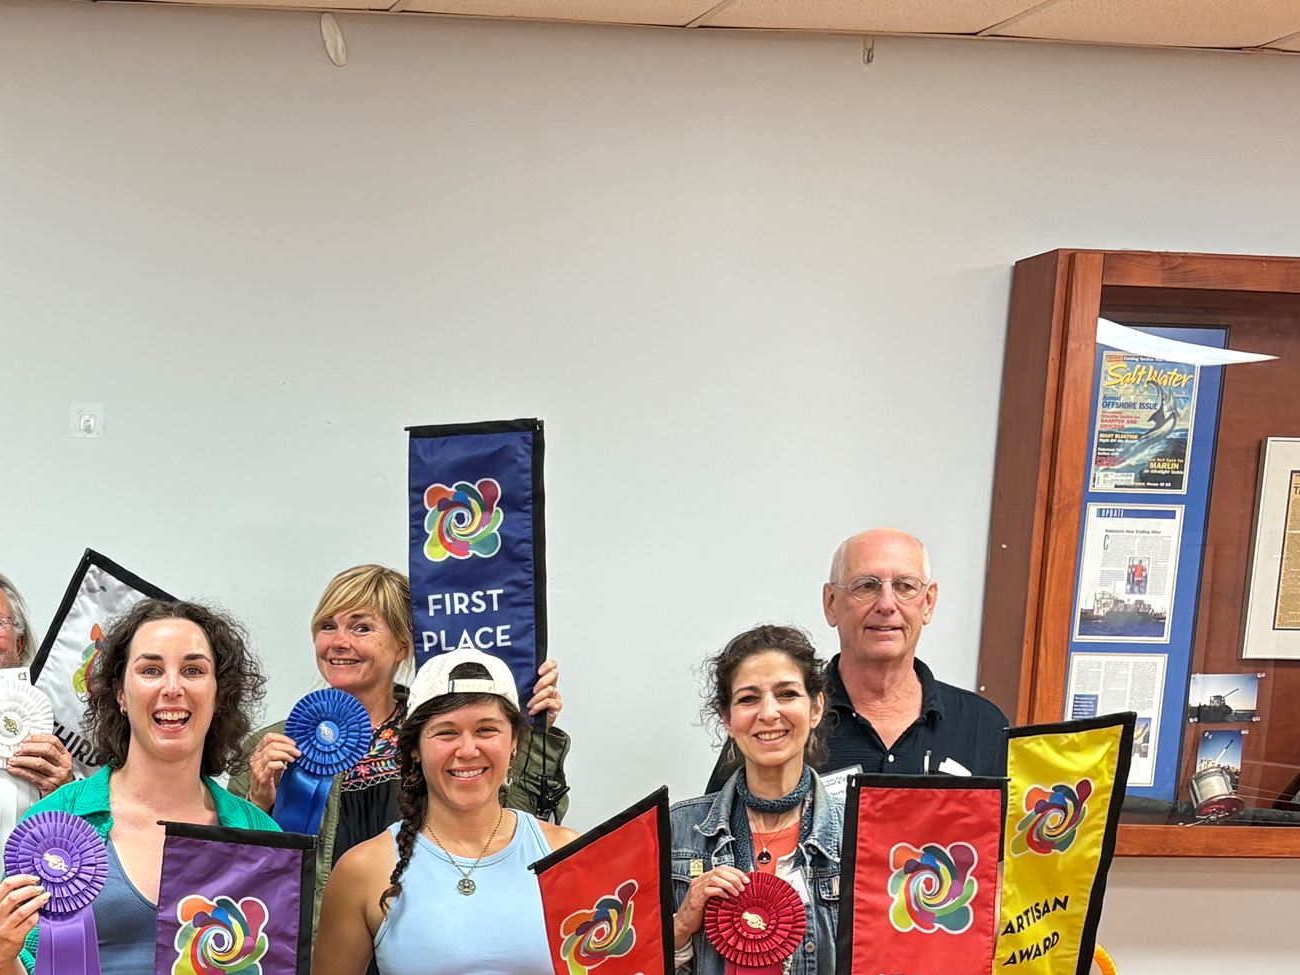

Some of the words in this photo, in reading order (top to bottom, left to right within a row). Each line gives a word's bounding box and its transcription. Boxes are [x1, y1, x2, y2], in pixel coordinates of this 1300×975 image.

[1106, 362, 1146, 387] Salt
[1144, 365, 1194, 388] Water
[1102, 400, 1137, 410] OFFSHORE
[1139, 402, 1158, 410] ISSUE
[1149, 462, 1180, 470] MARLIN
[428, 589, 504, 616] FIRST
[422, 624, 512, 652] PLACE
[1001, 895, 1069, 936] ARTISAN
[1002, 931, 1060, 966] AWARD
